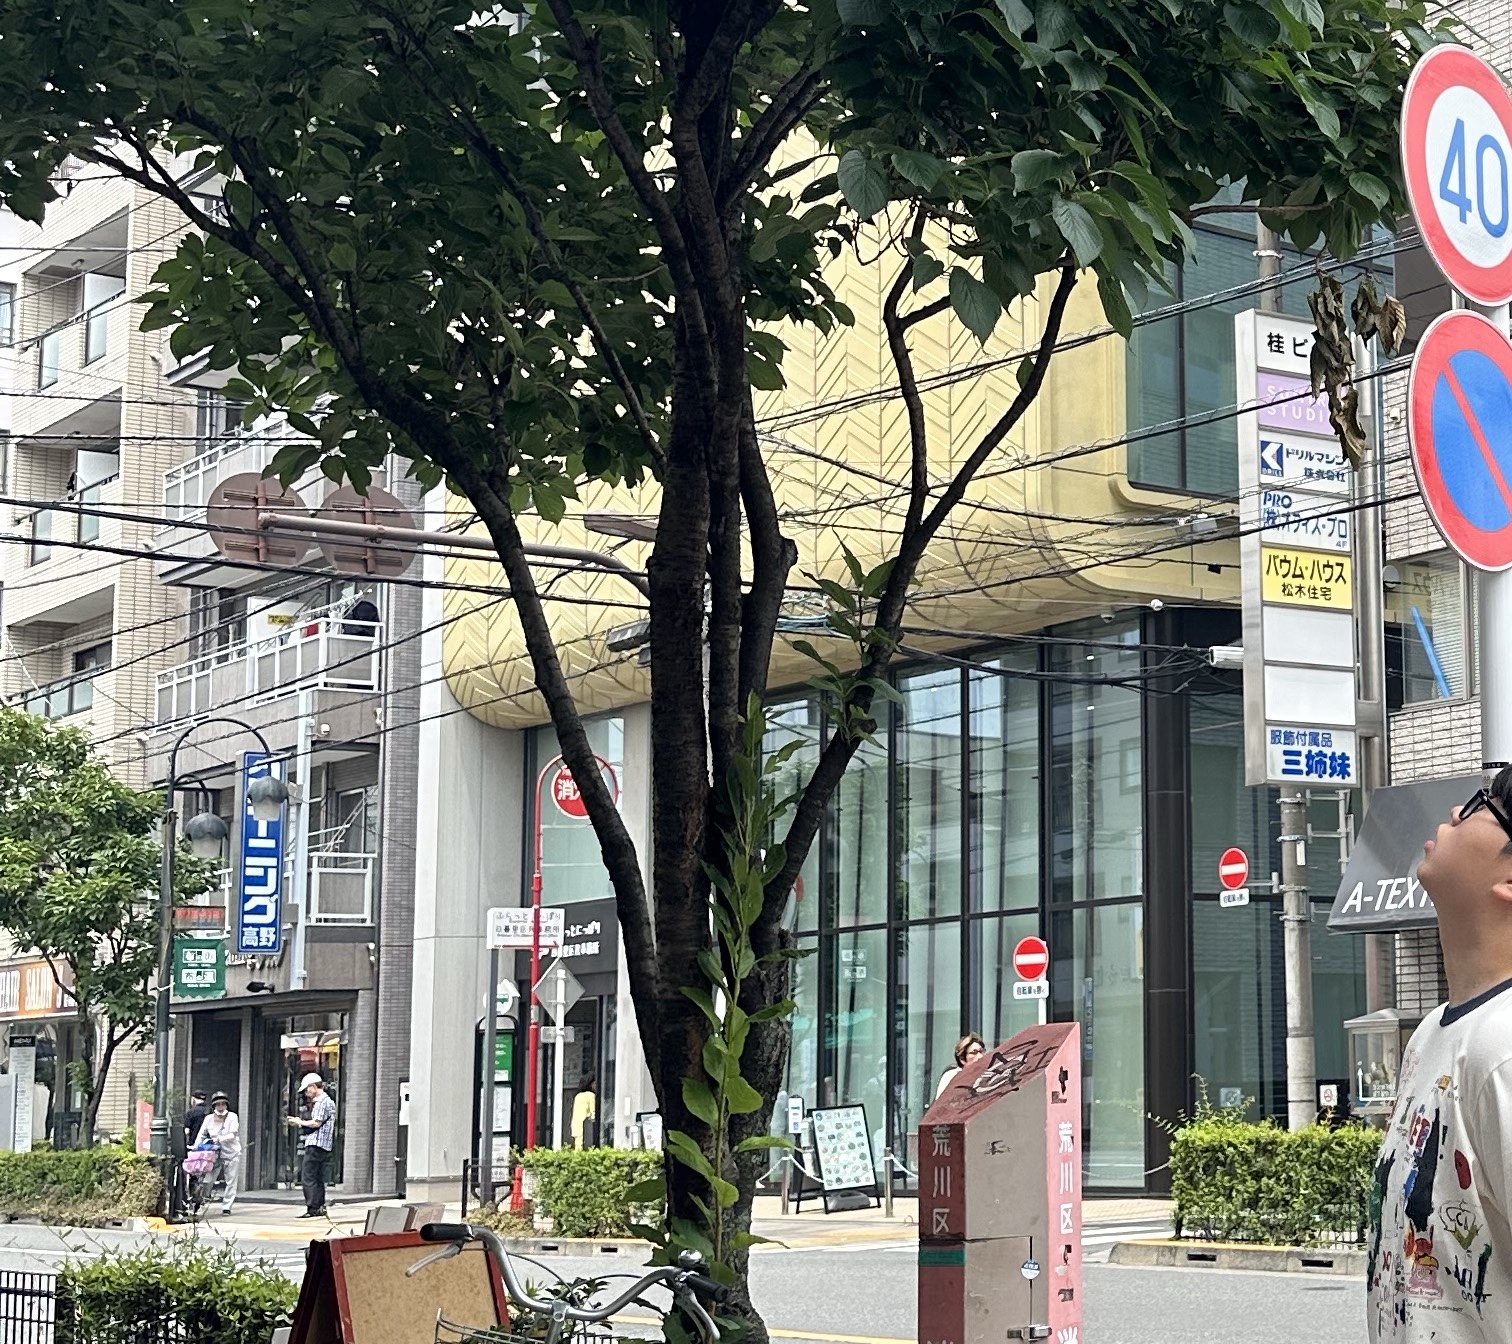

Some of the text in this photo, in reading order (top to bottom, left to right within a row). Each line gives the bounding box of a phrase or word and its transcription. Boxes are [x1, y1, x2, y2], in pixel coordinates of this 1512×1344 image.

[1439, 117, 1509, 239] 40
[1266, 331, 1309, 358] 桂ビ
[1267, 404, 1324, 423] STUDI
[1285, 447, 1345, 466] ドリルマシン
[1304, 467, 1346, 482] 株式会社
[1263, 491, 1293, 509] PRO
[1335, 540, 1347, 548] 4F
[1281, 582, 1332, 601] 松木住宅
[1270, 729, 1333, 748] 服飾付属品
[1281, 749, 1351, 780] 三姉妹
[243, 759, 281, 924] クーニング
[1341, 876, 1435, 914] A-TEX
[242, 926, 276, 948] 高野
[932, 1124, 951, 1235] 荒川区
[1058, 1121, 1074, 1235] 荒川区
